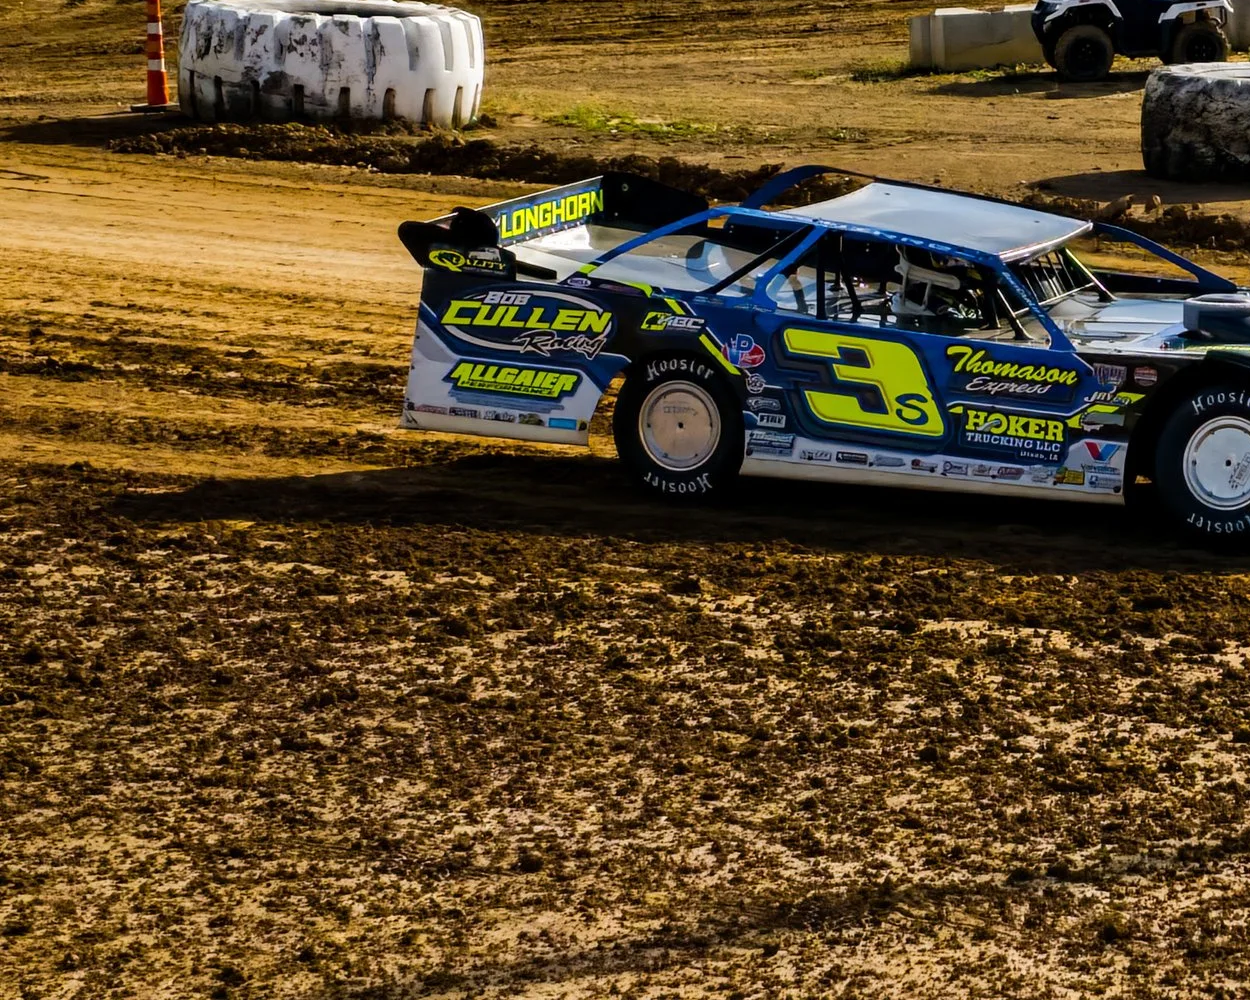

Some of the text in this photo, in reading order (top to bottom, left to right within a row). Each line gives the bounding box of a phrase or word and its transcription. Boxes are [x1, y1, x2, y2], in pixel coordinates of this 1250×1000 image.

[501, 189, 604, 239] LONGHORN
[483, 291, 531, 305] BOB
[441, 300, 613, 333] CULLEN
[512, 329, 608, 360] Racing
[451, 362, 582, 396] ALLGAIER
[647, 359, 715, 381] Hoosier
[946, 345, 1078, 386] Thomason
[783, 327, 945, 438] 3
[965, 376, 1053, 395] Express
[965, 409, 1065, 442] HOKER
[966, 432, 1061, 453] TRUCKING LLC
[644, 472, 713, 493] Hoosier
